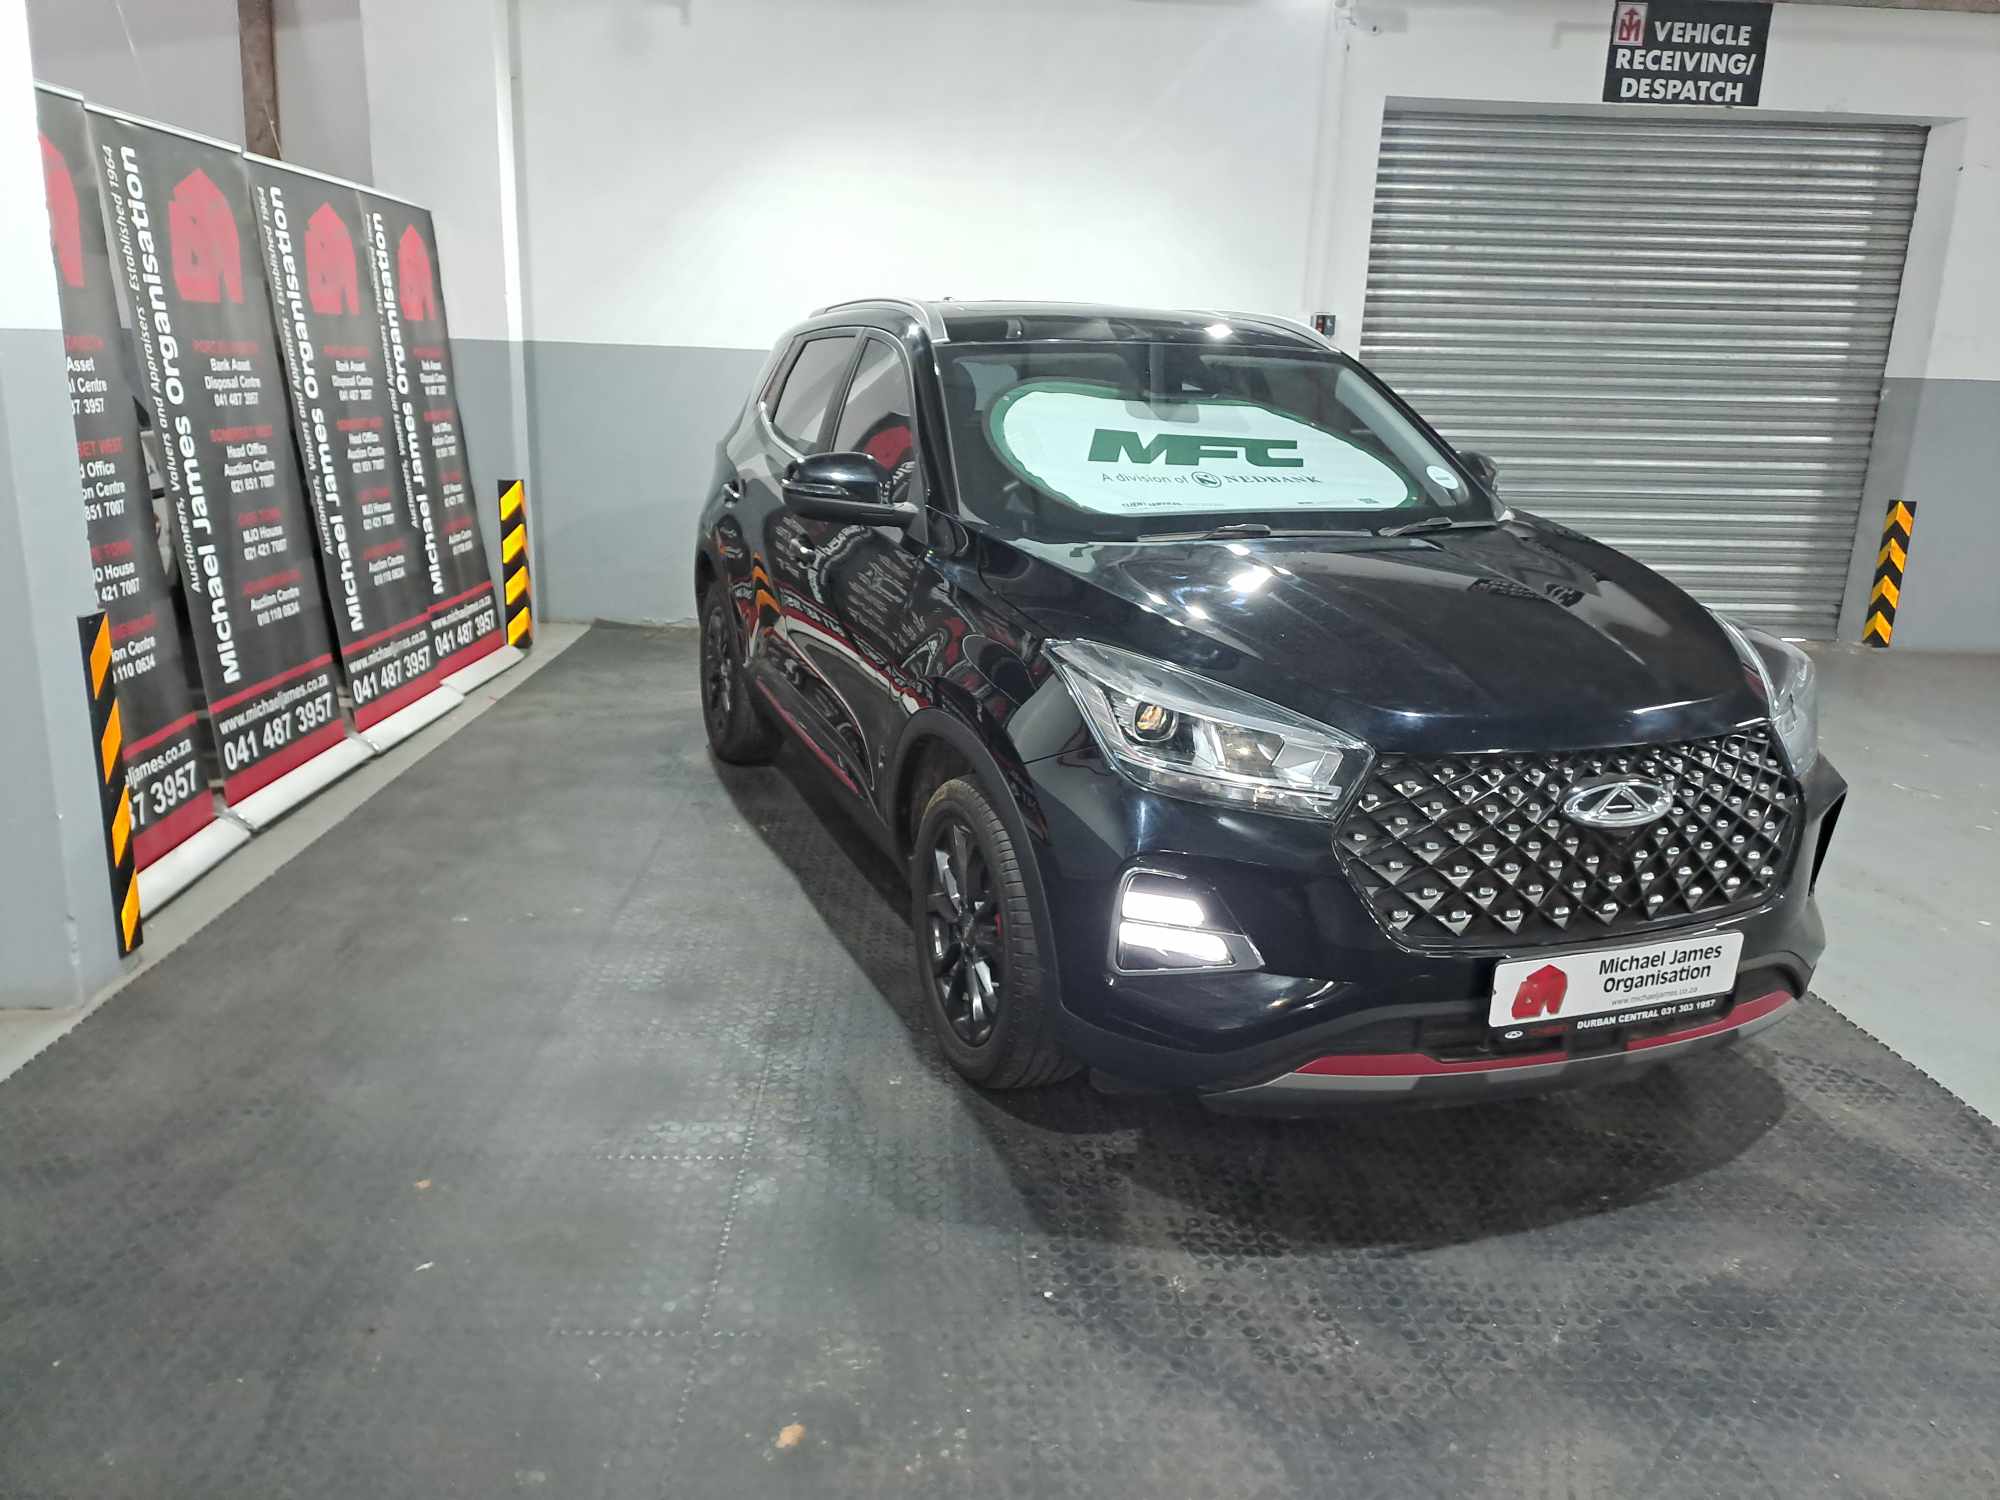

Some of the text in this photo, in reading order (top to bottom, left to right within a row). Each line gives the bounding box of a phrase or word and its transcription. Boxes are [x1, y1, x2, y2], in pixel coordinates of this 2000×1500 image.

[1654, 21, 1752, 46] VEHICLE
[1616, 48, 1757, 75] RECEIVING/
[1620, 77, 1744, 102] DESPATCH
[102, 145, 120, 189] 1964
[112, 192, 141, 291] Established
[67, 356, 95, 372] Asset
[136, 305, 162, 395] Appraisers
[77, 377, 108, 393] Centre
[83, 397, 105, 414] 3957
[120, 146, 241, 684] Michael James Organisation
[153, 396, 168, 429] and
[270, 186, 364, 632] Michael James Organisation
[373, 213, 444, 594] Michael James Organisation
[162, 433, 181, 491] Valuers
[1087, 428, 1304, 467] MFC
[87, 460, 115, 477] Office
[1101, 472, 1113, 483] A
[1115, 472, 1172, 484] division
[1174, 474, 1190, 485] of
[96, 480, 126, 497] Centre
[176, 497, 202, 593] Auctioneers,
[104, 562, 136, 580] House
[101, 583, 119, 601] 421
[128, 636, 156, 656] Centre
[434, 609, 495, 656] 041 487 3957
[118, 661, 135, 680] 110
[353, 645, 430, 704] 041 487 3957
[224, 692, 332, 771] 041 487 3957
[150, 760, 196, 813] 3957
[1598, 945, 1723, 976] Michael James
[1603, 964, 1711, 993] Organisation
[1576, 1015, 1616, 1030] DURBAN
[1618, 1009, 1660, 1024] CENTRAL
[1660, 1005, 1676, 1016] 031
